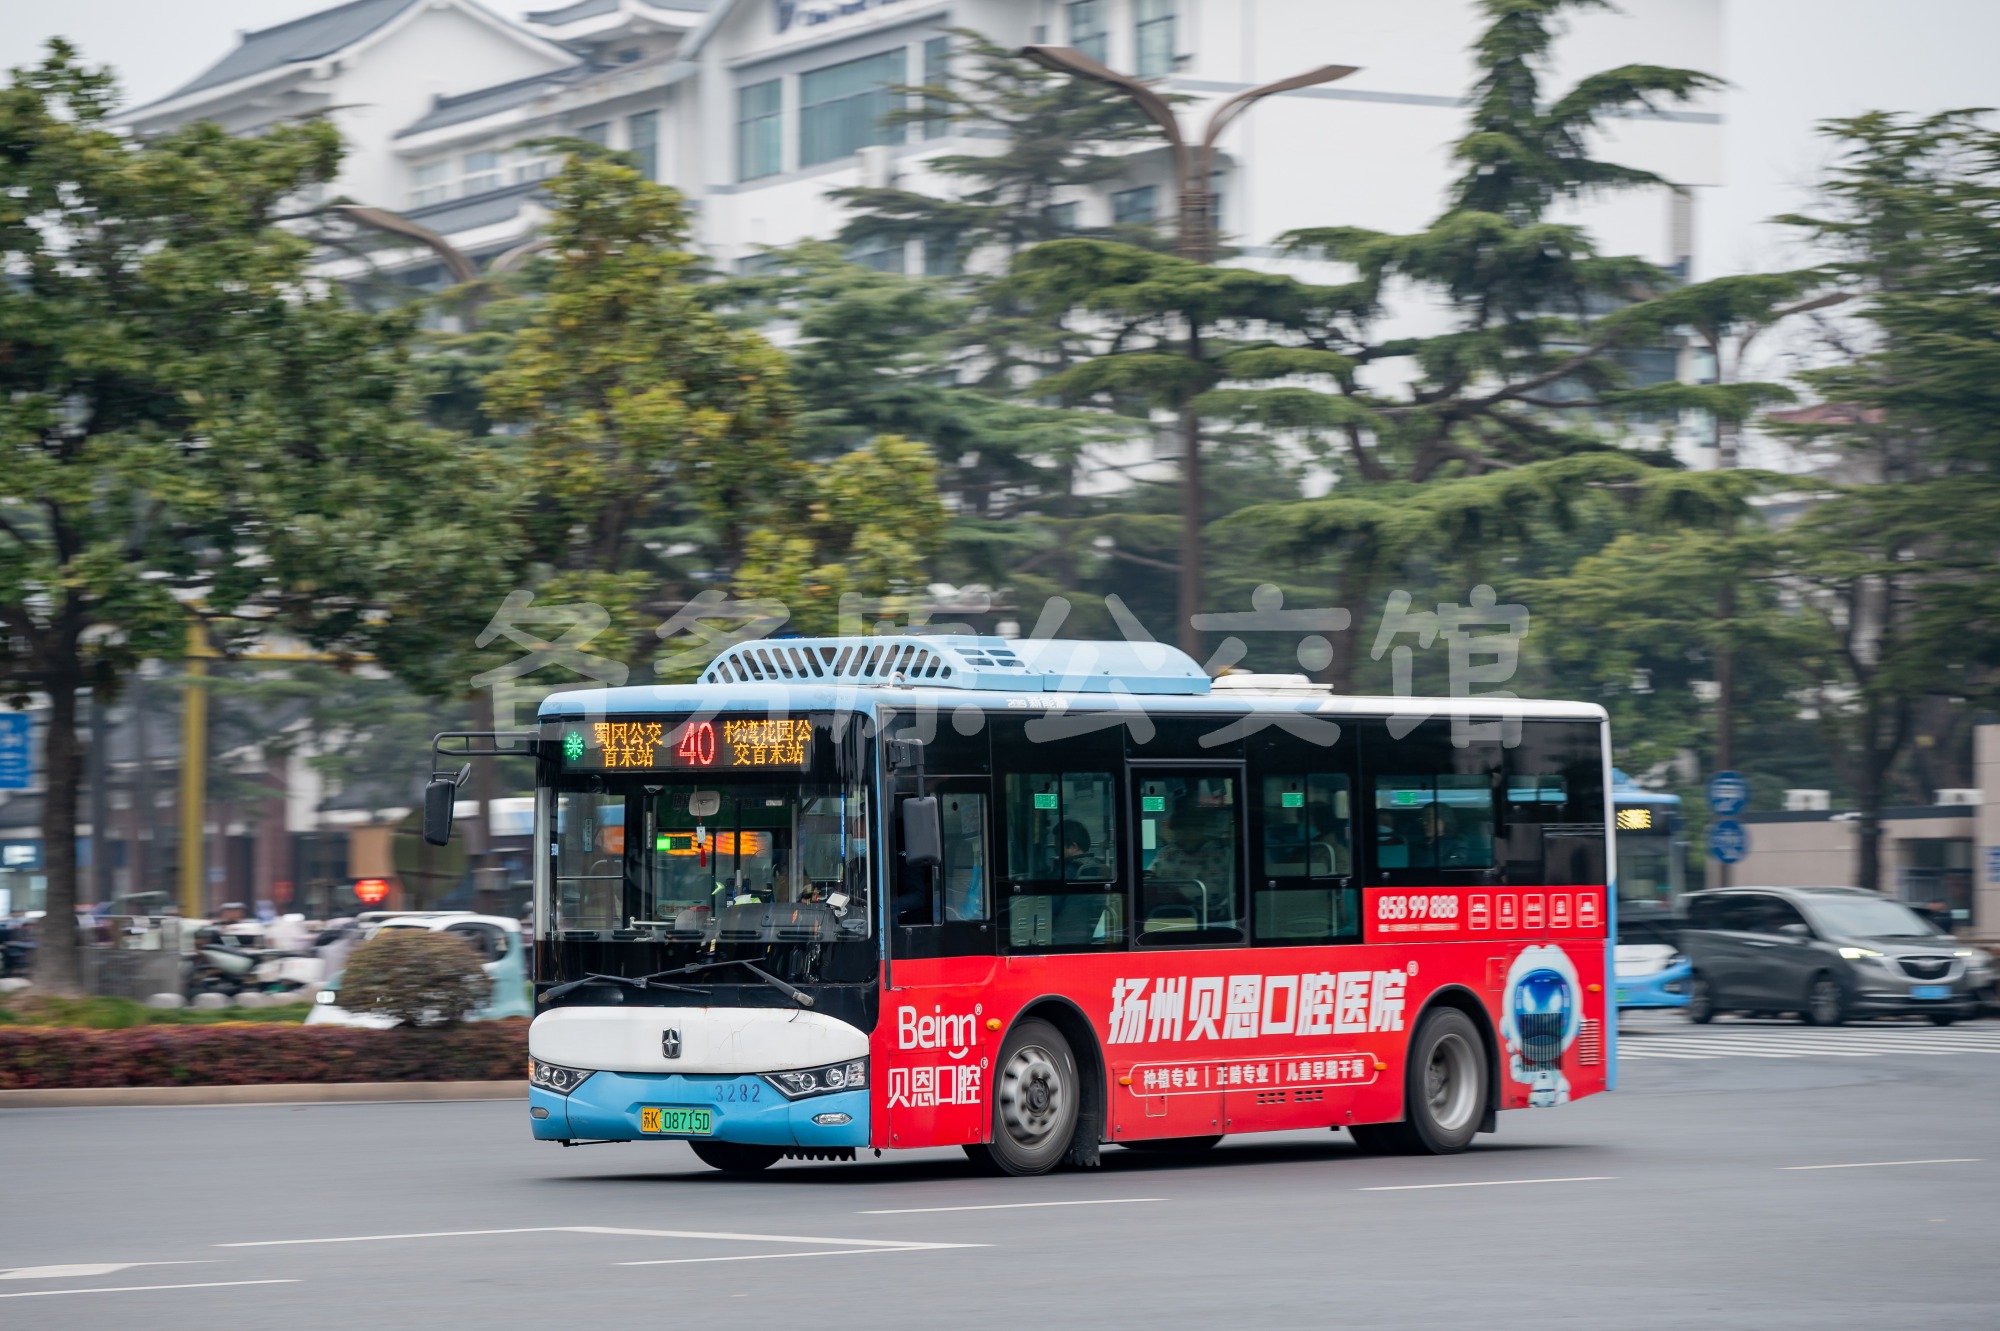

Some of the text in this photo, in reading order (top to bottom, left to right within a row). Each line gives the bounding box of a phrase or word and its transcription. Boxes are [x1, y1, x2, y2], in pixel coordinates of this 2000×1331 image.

[594, 722, 663, 746] 蜀冈公交
[679, 722, 715, 765] 40
[602, 745, 655, 768] 首末站
[733, 743, 805, 766] 交首末站
[1378, 895, 1459, 920] 858 99 888
[1106, 968, 1408, 1045] 扬州贝恩口腔医院
[714, 1083, 761, 1103] 3282
[886, 1064, 981, 1109] 贝恩口腔
[643, 1111, 710, 1131] 苏K 08715D
